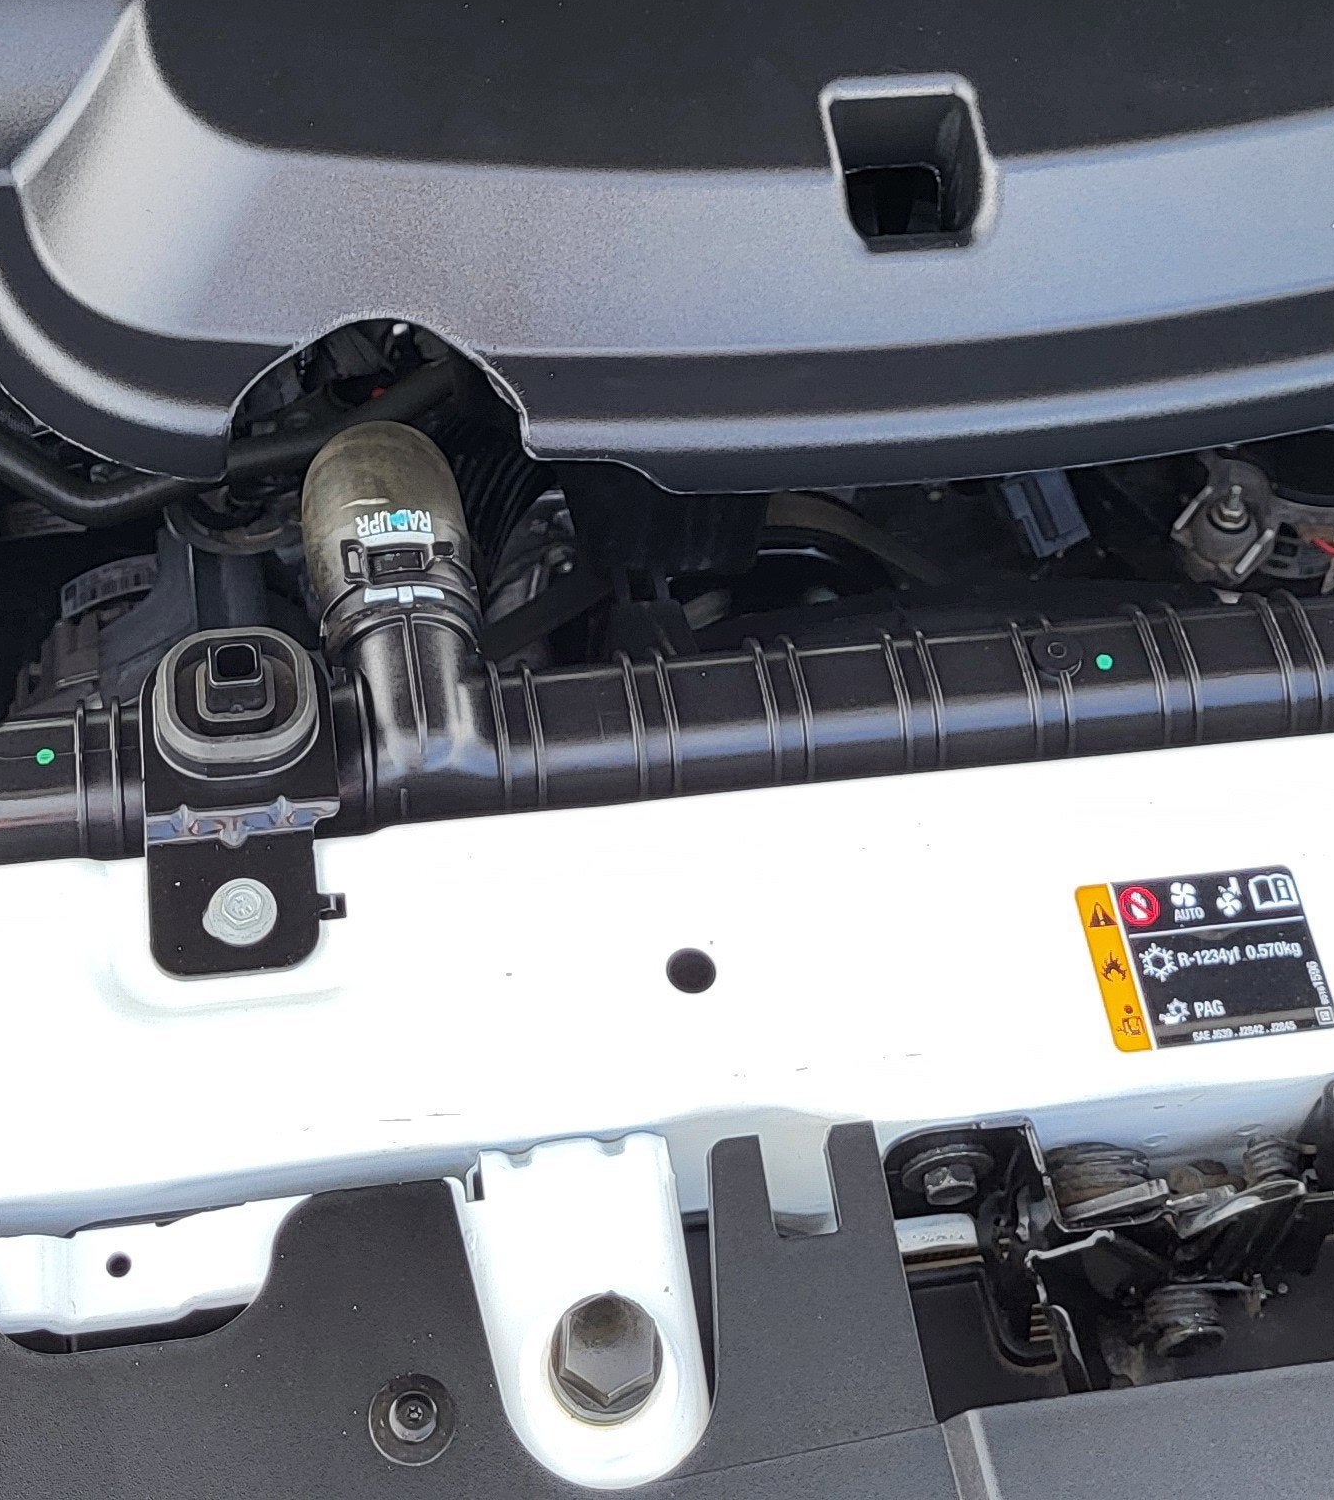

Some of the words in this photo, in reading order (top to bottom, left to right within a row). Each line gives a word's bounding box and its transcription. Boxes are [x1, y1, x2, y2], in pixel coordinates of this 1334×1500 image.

[354, 510, 393, 538] UPR
[1174, 906, 1206, 923] AUTO
[1176, 945, 1242, 968] R-1234yf
[1245, 940, 1304, 961] 0.570kg
[1193, 999, 1227, 1019] PAG
